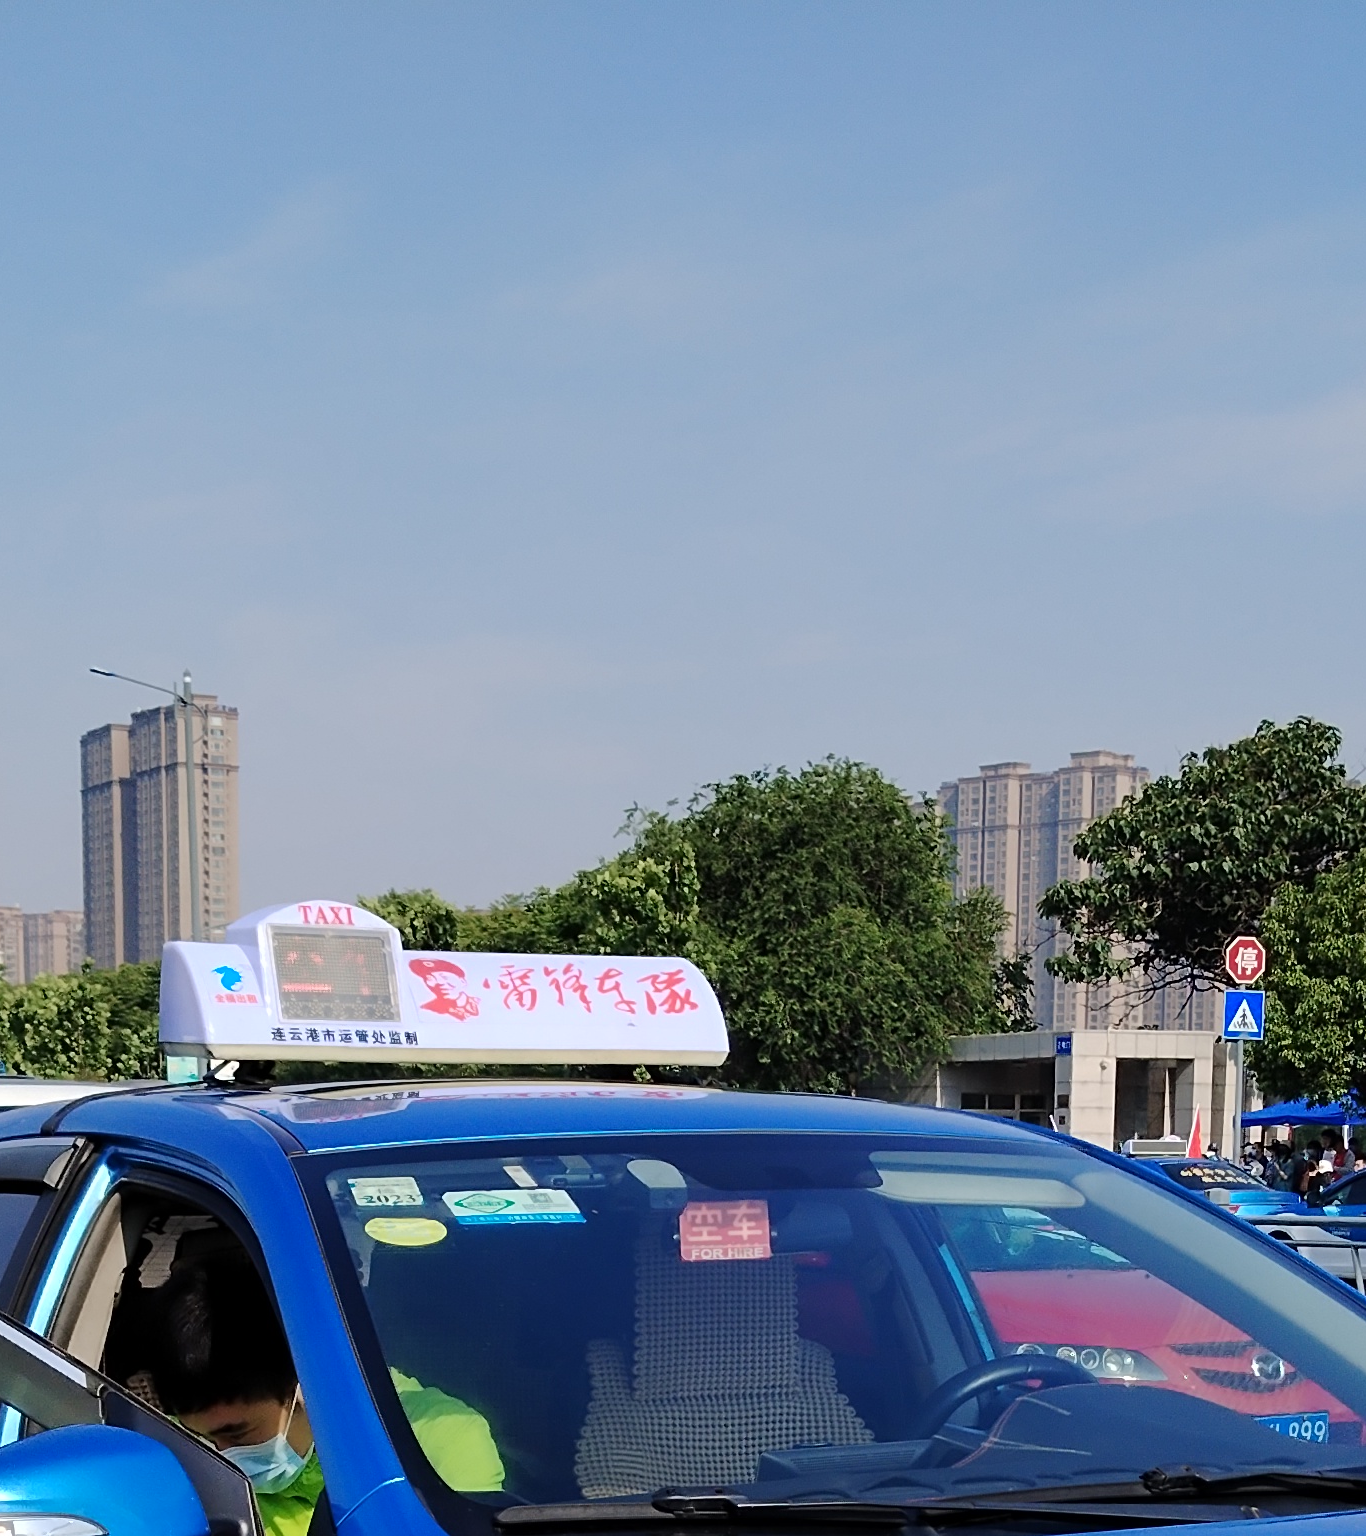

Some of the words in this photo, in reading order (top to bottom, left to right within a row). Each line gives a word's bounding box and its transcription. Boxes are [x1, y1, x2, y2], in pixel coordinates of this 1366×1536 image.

[298, 905, 355, 926] TAXI
[1235, 946, 1259, 976] 停
[271, 1027, 419, 1046] 连云港市运管处监制
[360, 1195, 417, 1204] 2023
[686, 1204, 763, 1241] 空车
[691, 1248, 723, 1260] FOR
[728, 1247, 764, 1259] HIRE
